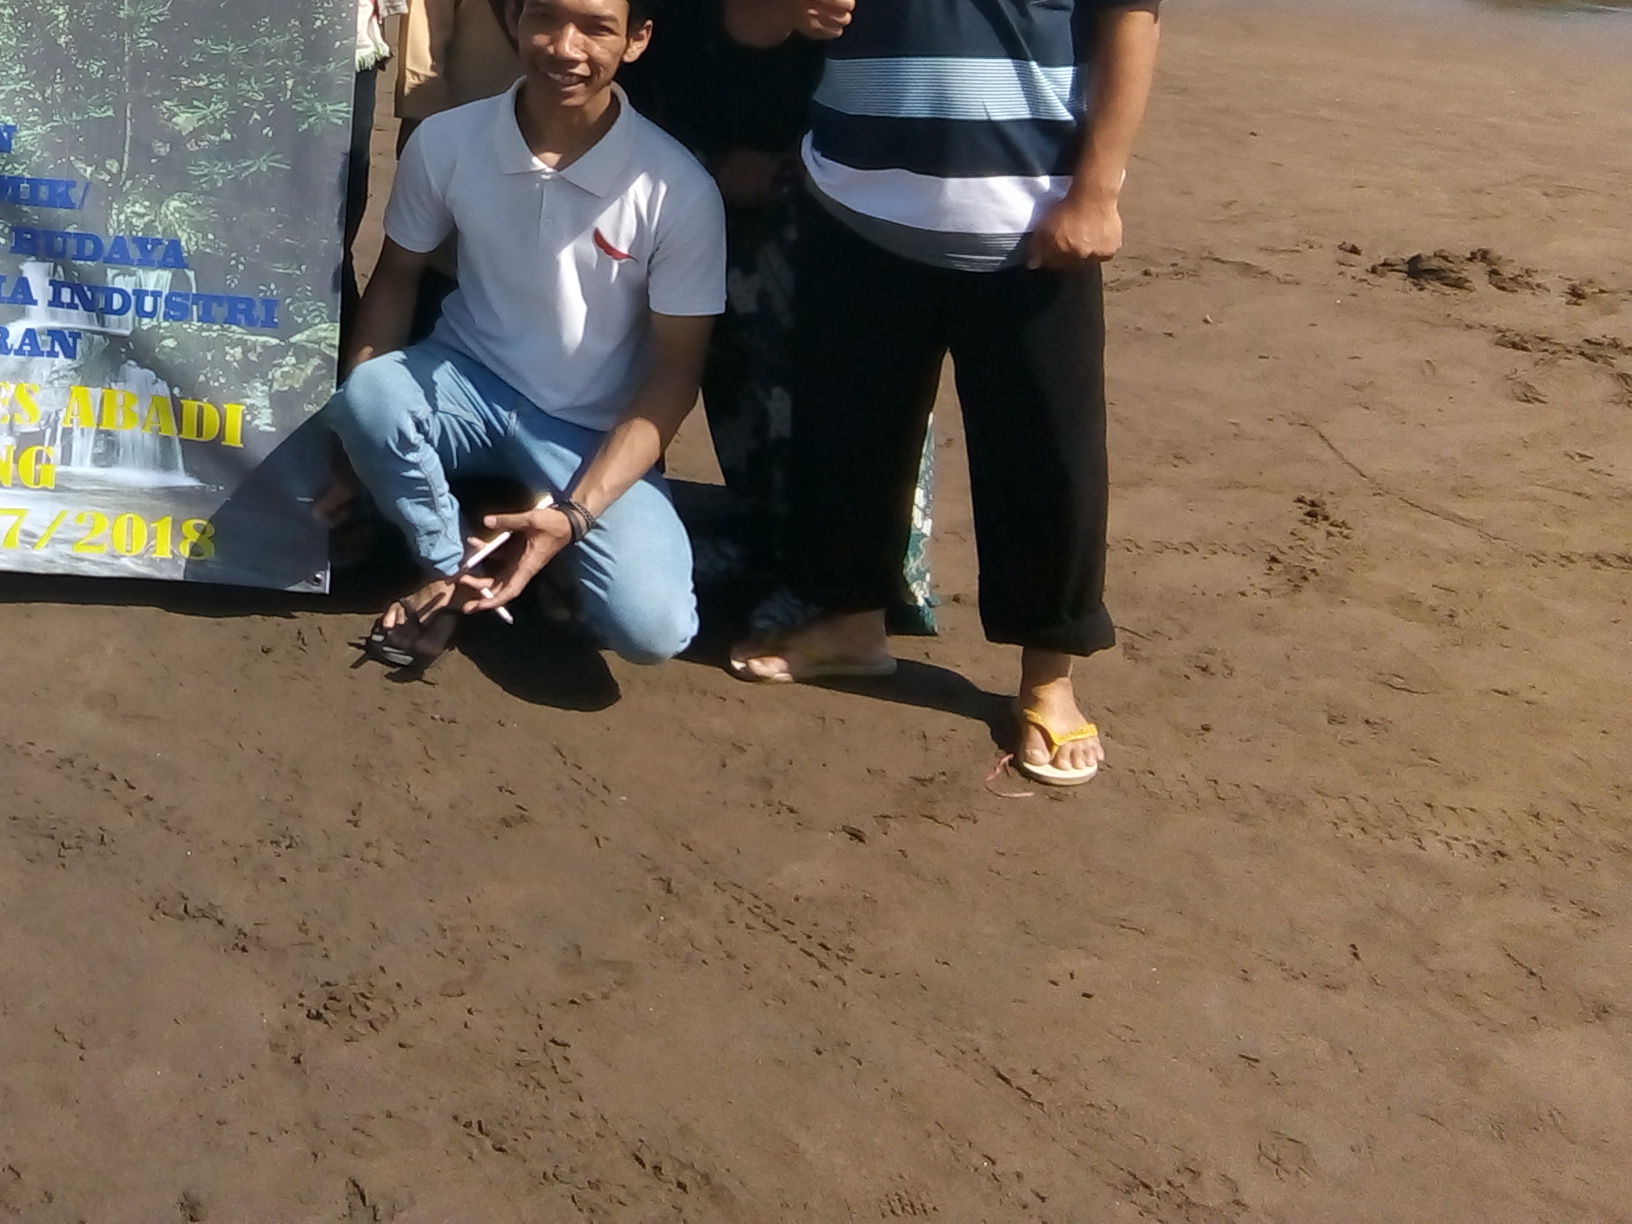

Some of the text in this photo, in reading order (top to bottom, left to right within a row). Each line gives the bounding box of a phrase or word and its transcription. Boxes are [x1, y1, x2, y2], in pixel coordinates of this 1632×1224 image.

[9, 226, 189, 269] BUDAYA
[47, 279, 280, 329] INDUSTRI
[62, 385, 247, 449] ABADI
